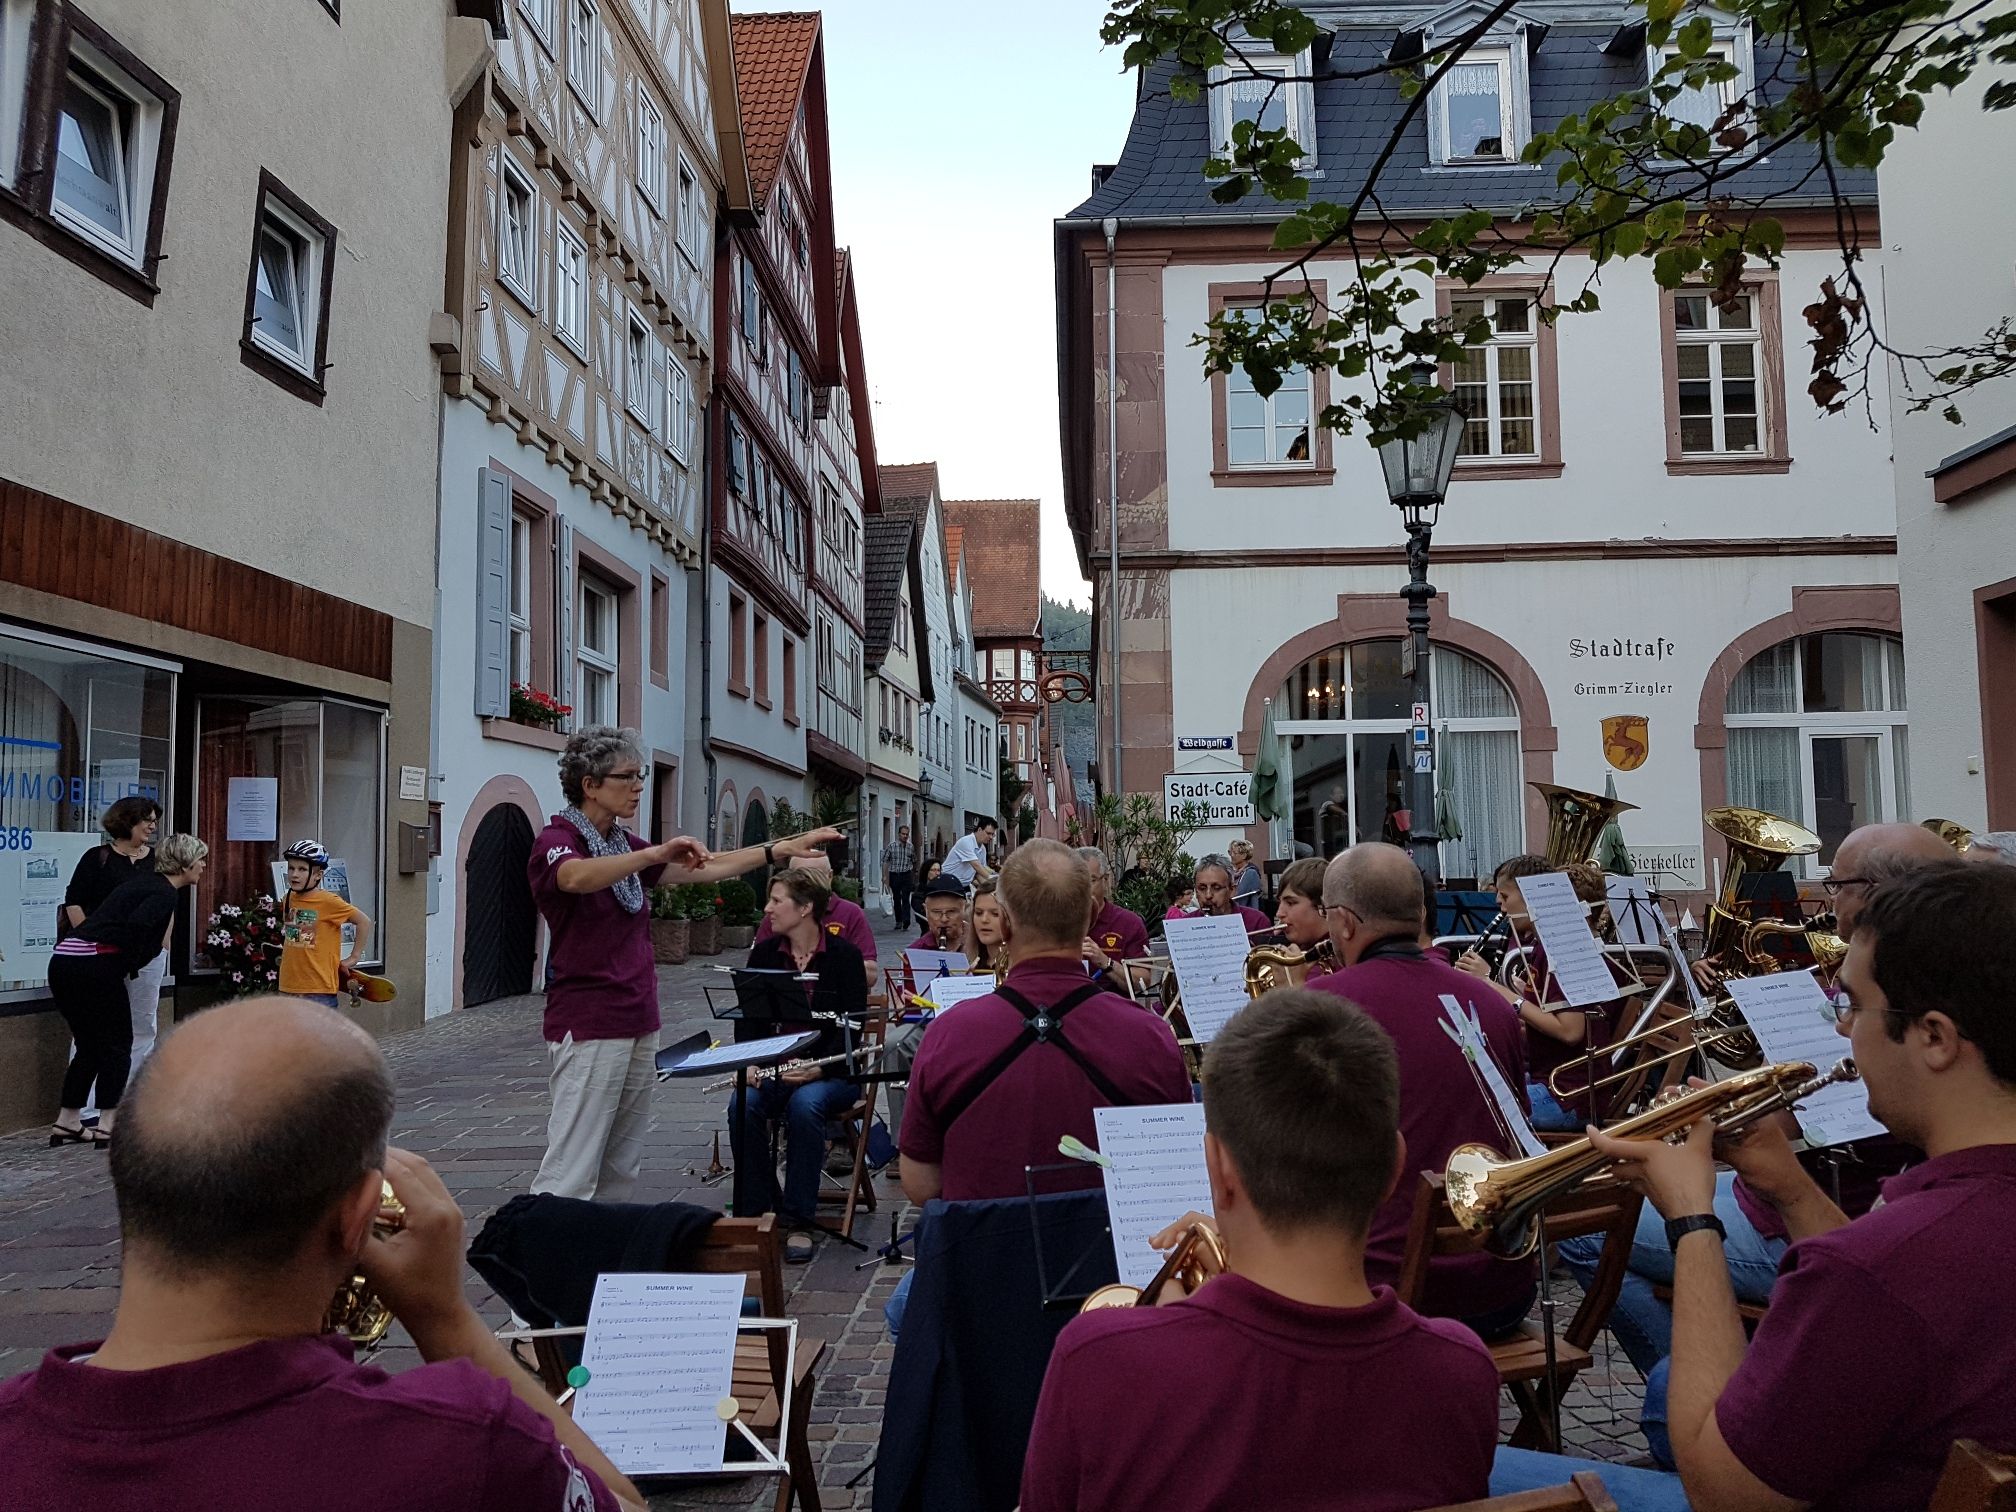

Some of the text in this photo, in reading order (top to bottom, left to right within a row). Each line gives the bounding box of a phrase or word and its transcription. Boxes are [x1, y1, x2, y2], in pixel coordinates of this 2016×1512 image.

[1574, 682, 1673, 697] Grimm-Ziegler
[1414, 706, 1425, 721] R
[1170, 780, 1248, 798] Stadt-Café
